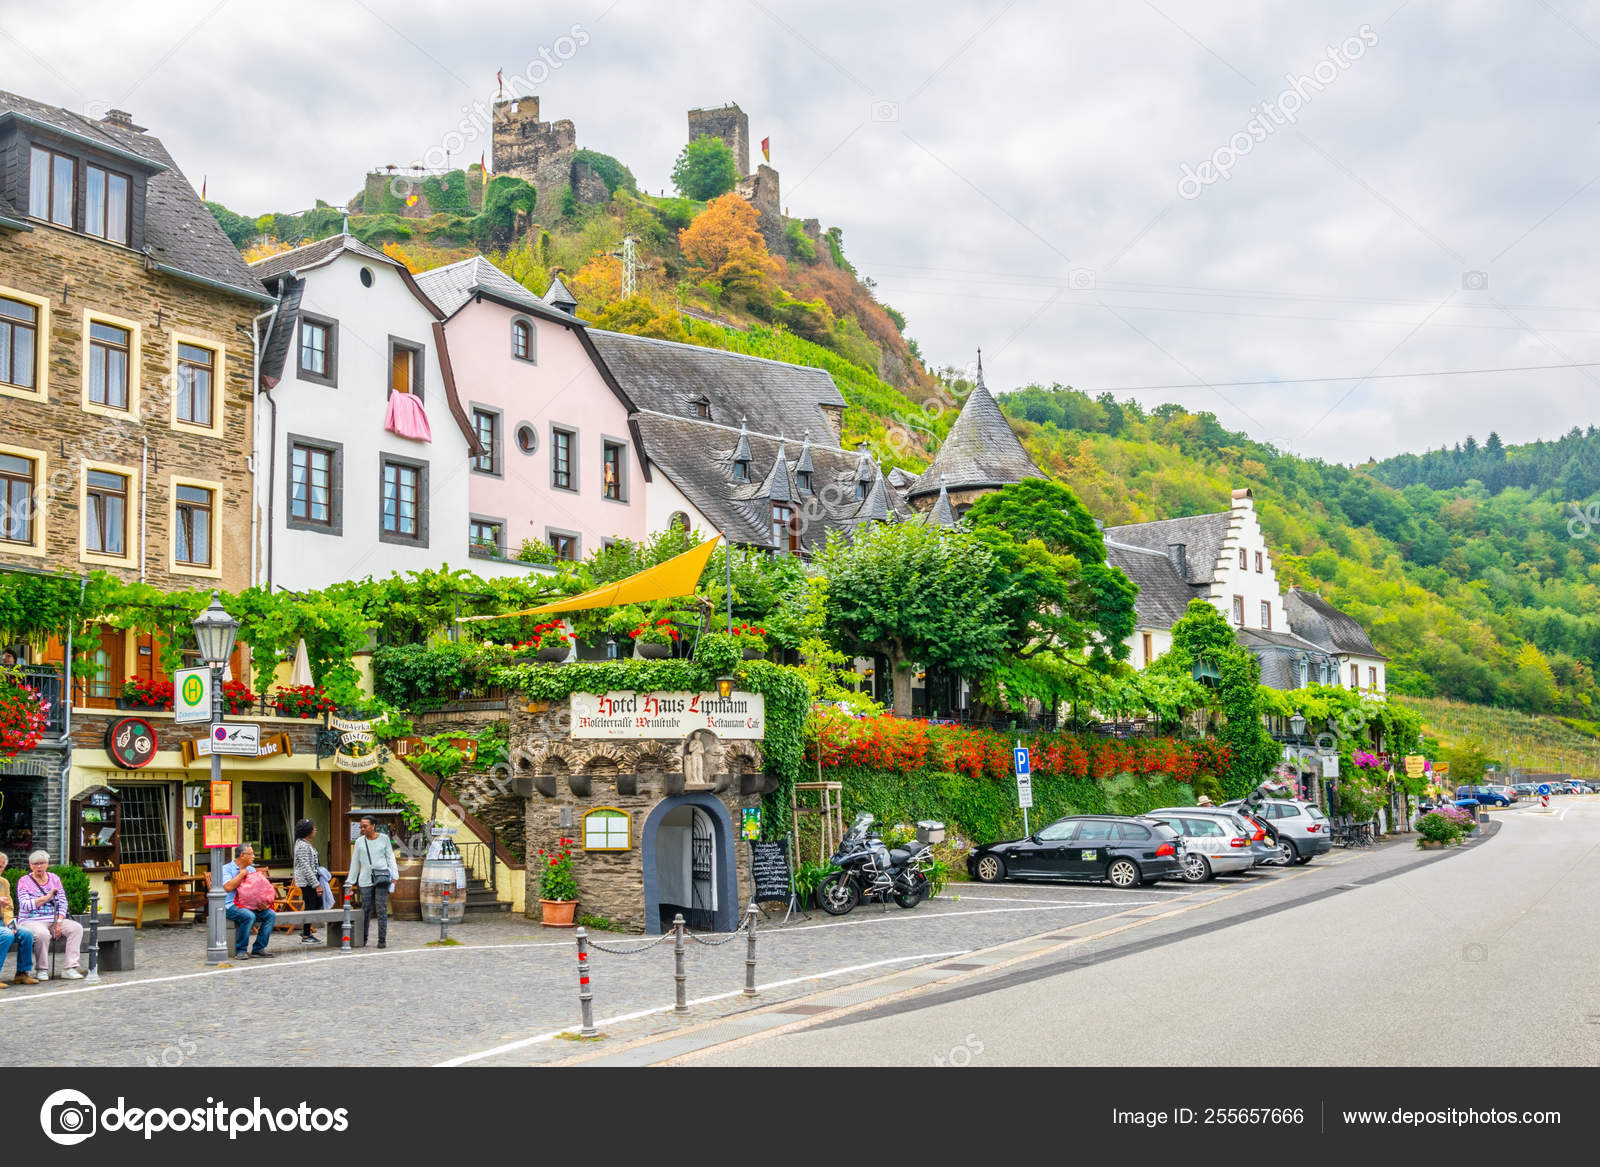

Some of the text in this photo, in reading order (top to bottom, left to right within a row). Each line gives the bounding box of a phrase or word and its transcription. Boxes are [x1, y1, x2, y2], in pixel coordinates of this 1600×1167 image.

[188, 681, 199, 699] H
[596, 692, 748, 717] Hotel Haus Lipmann
[342, 733, 370, 743] Bistro
[1017, 751, 1026, 773] P
